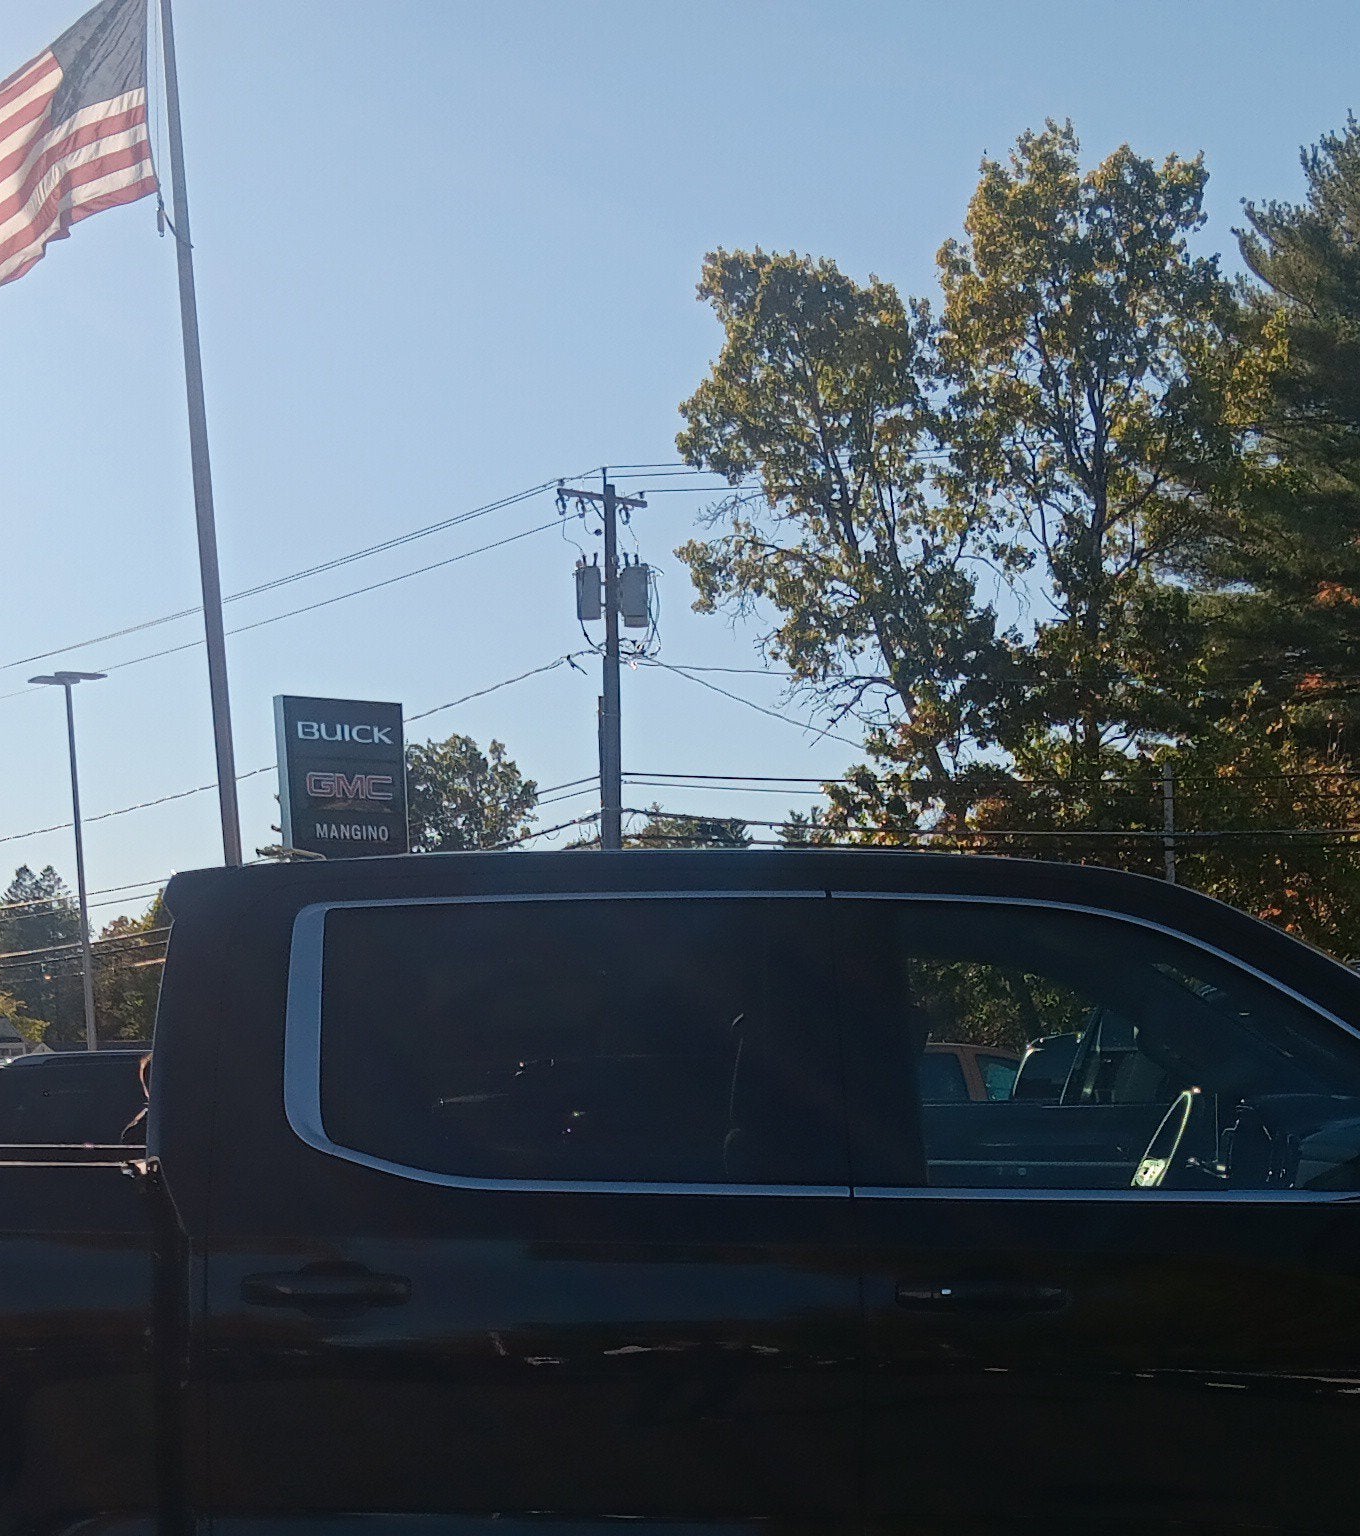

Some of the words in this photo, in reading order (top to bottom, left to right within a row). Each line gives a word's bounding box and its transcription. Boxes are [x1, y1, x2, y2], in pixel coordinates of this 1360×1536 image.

[297, 721, 394, 745] BUICK
[306, 771, 393, 801] GMC
[315, 822, 389, 842] MANGINO
